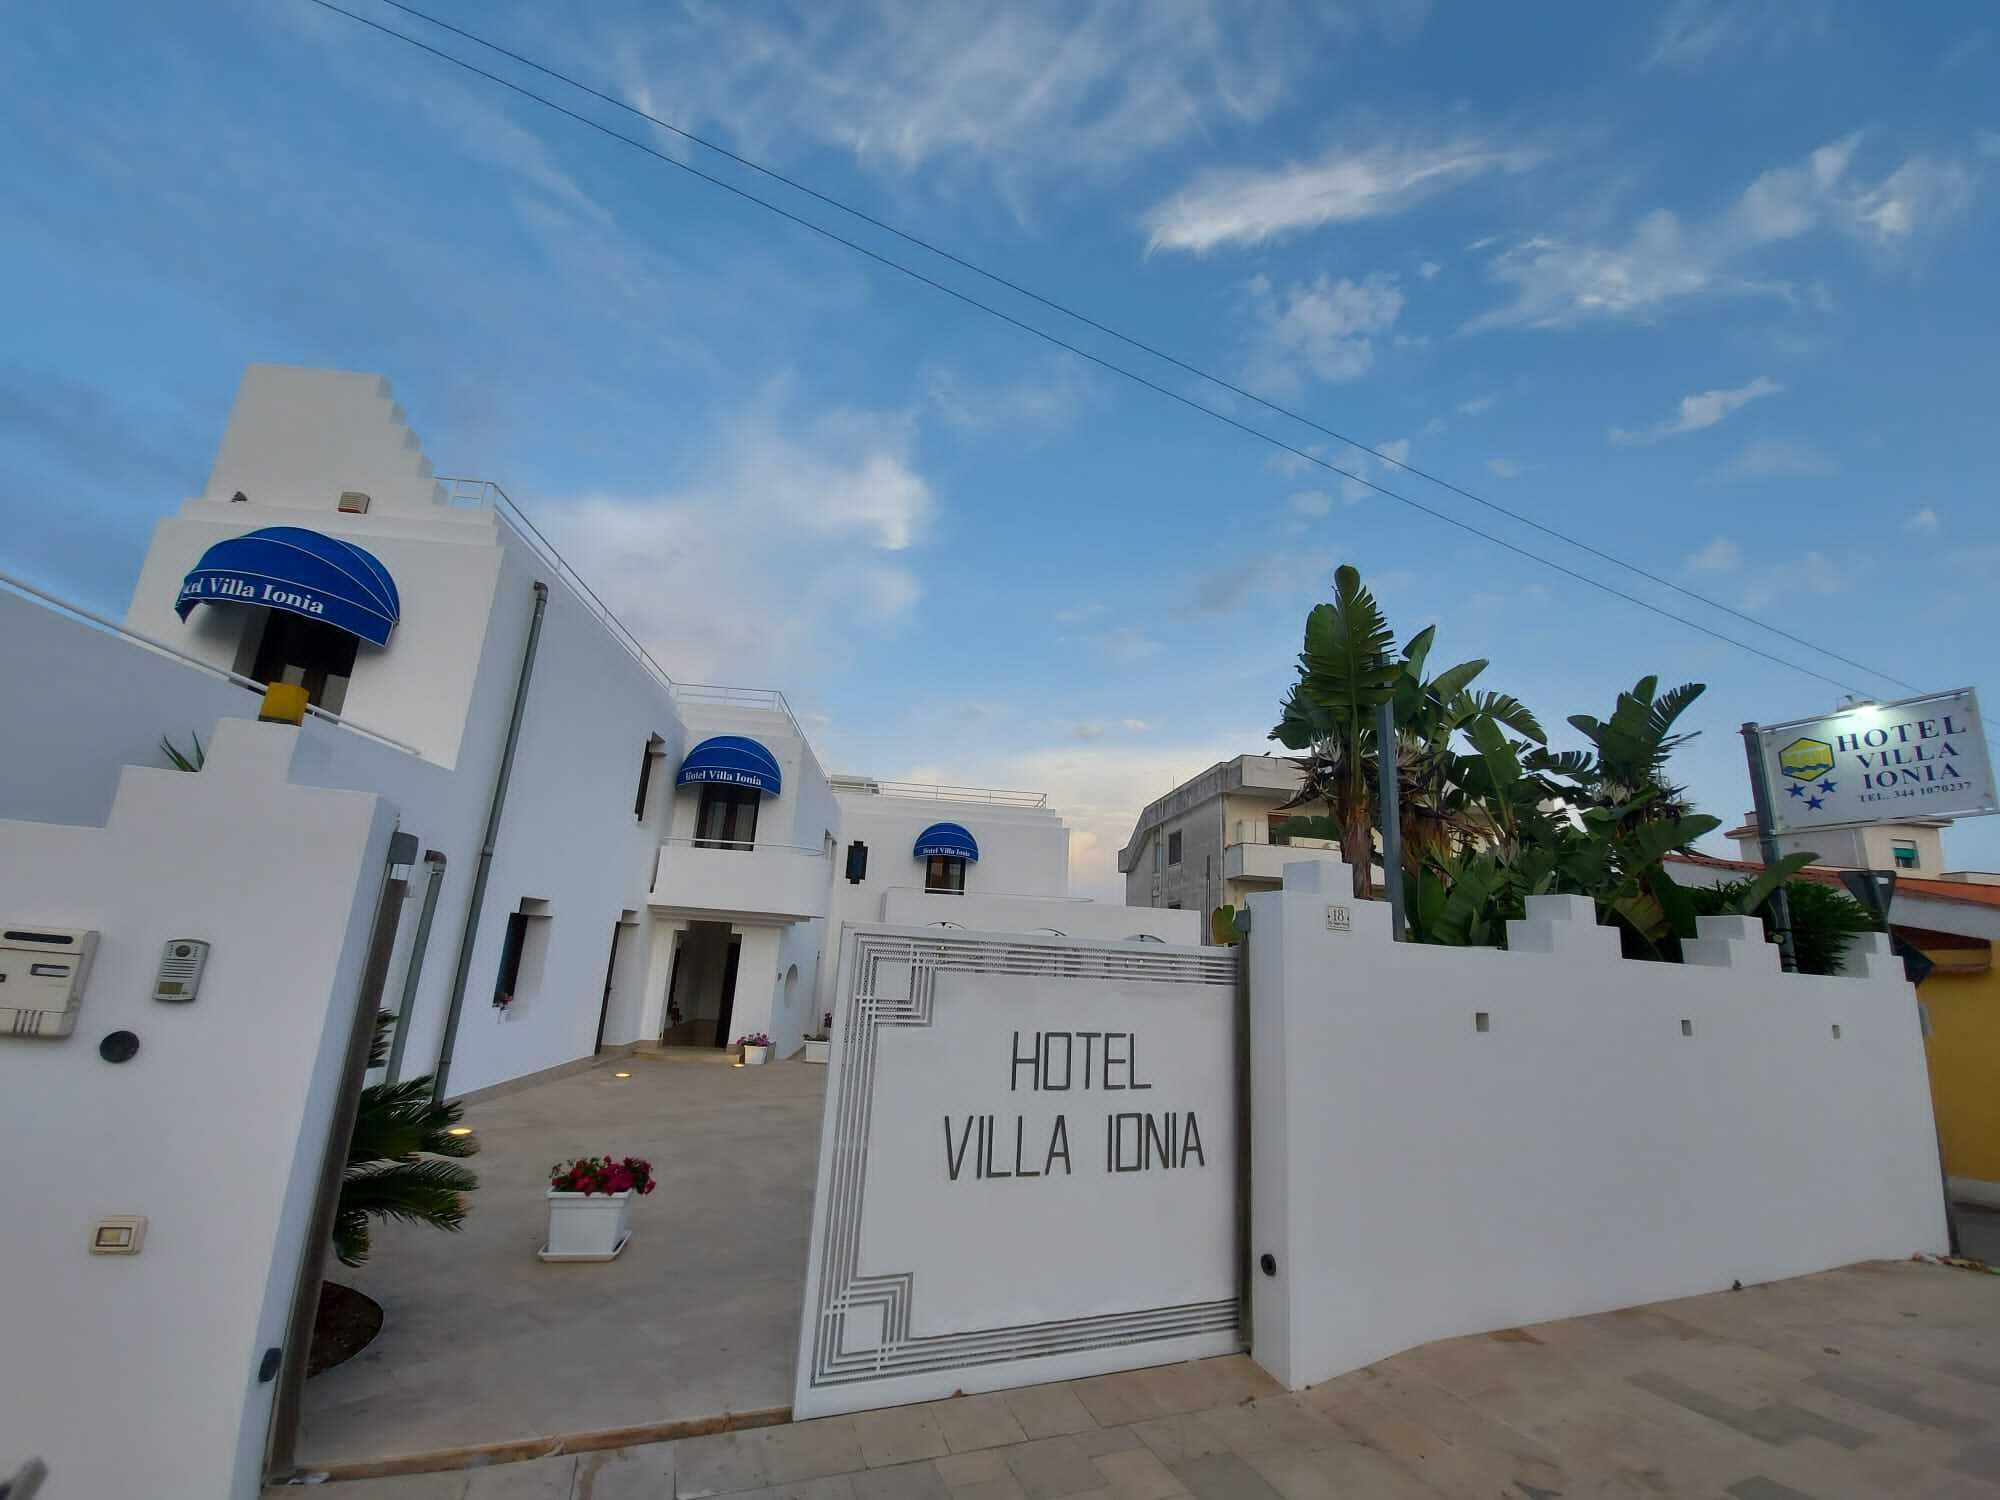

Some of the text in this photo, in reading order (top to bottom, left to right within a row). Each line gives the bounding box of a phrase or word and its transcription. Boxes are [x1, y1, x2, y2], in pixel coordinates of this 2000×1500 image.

[209, 577, 255, 598] Villa
[260, 584, 325, 614] Ionia
[1835, 715, 1966, 753] HOTEL
[1856, 741, 1960, 770] VILLA
[685, 770, 761, 786] Hotel Villa Ionia
[1863, 763, 1961, 790] IONIA
[1894, 788, 1915, 799] 344
[1010, 1031, 1152, 1091] HOTEL
[944, 1111, 1205, 1180] VILLA IONIA
